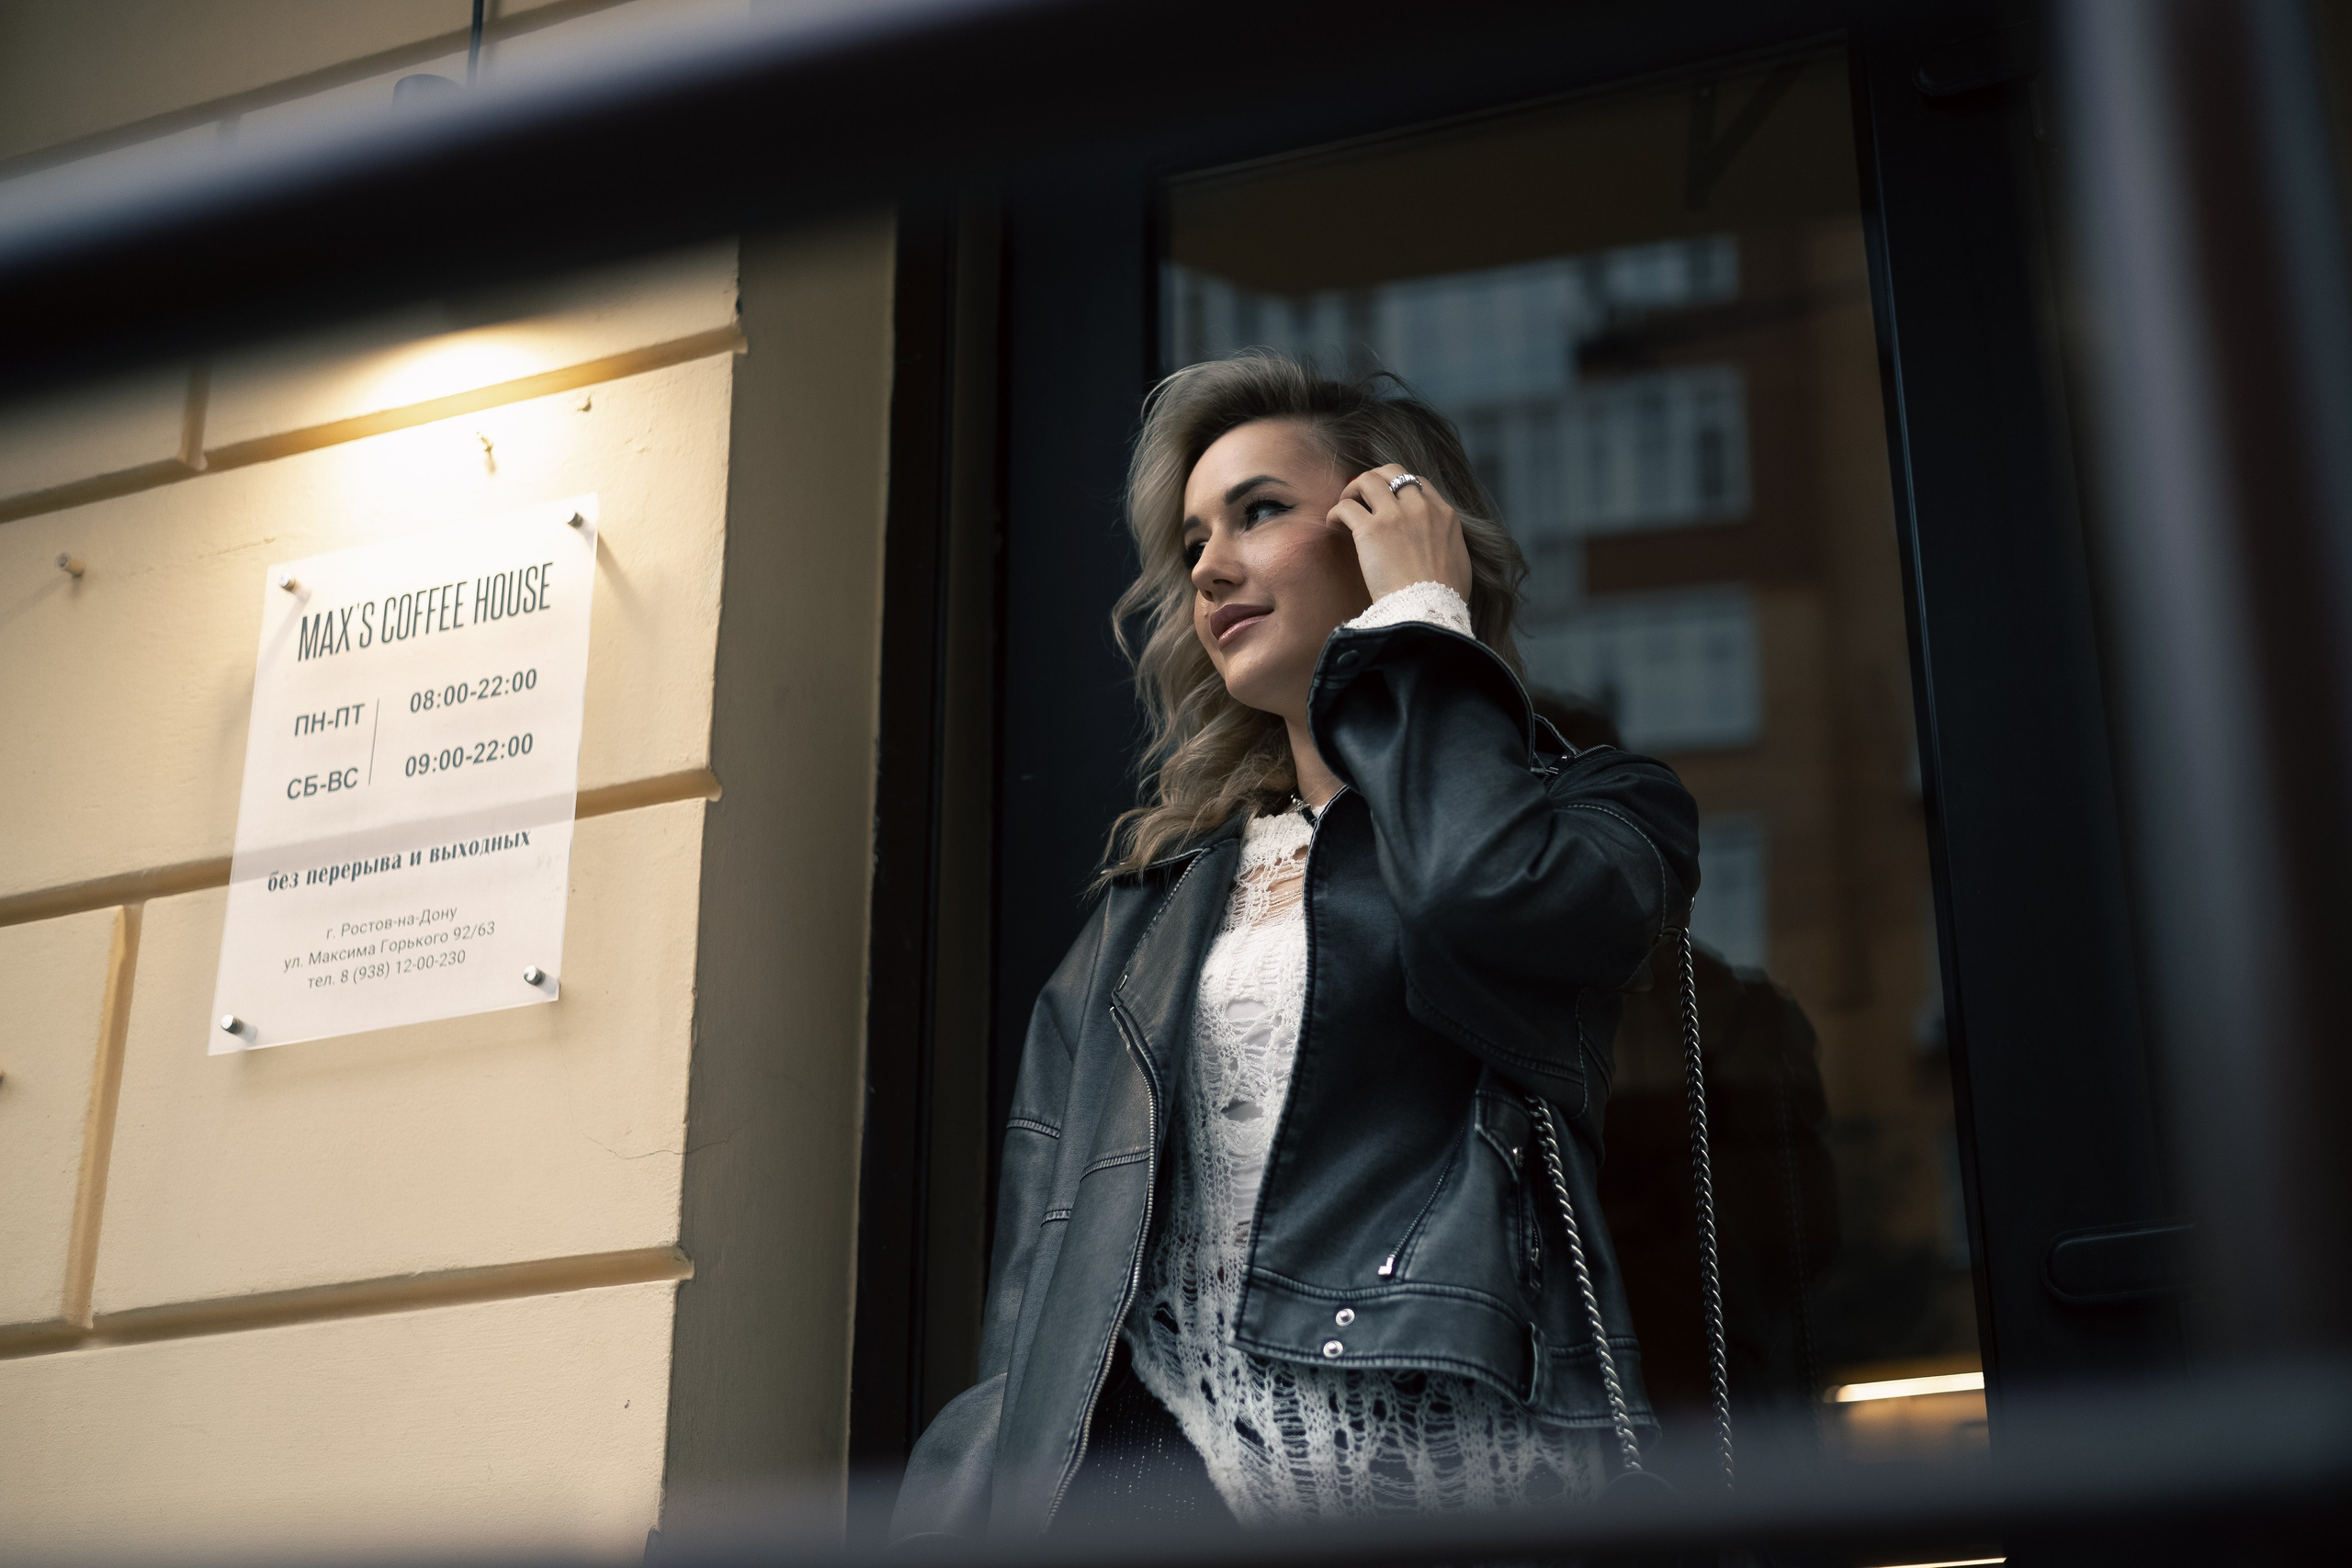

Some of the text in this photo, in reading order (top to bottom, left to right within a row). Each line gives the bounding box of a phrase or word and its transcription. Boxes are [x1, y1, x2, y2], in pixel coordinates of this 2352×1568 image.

[298, 561, 554, 661] MAX'S COFFEE HOUSE
[294, 668, 537, 737] ПН-ПТ 08:00-22:00
[287, 732, 534, 800] СБ-ВС 09:00-22:00
[267, 829, 532, 892] без перерыва и выходных
[283, 920, 495, 974] ул. Максима Горького 92/63
[325, 906, 458, 941] г. Ростов-на-Дону
[308, 949, 466, 989] тел. 8 (938) 12-00-230
